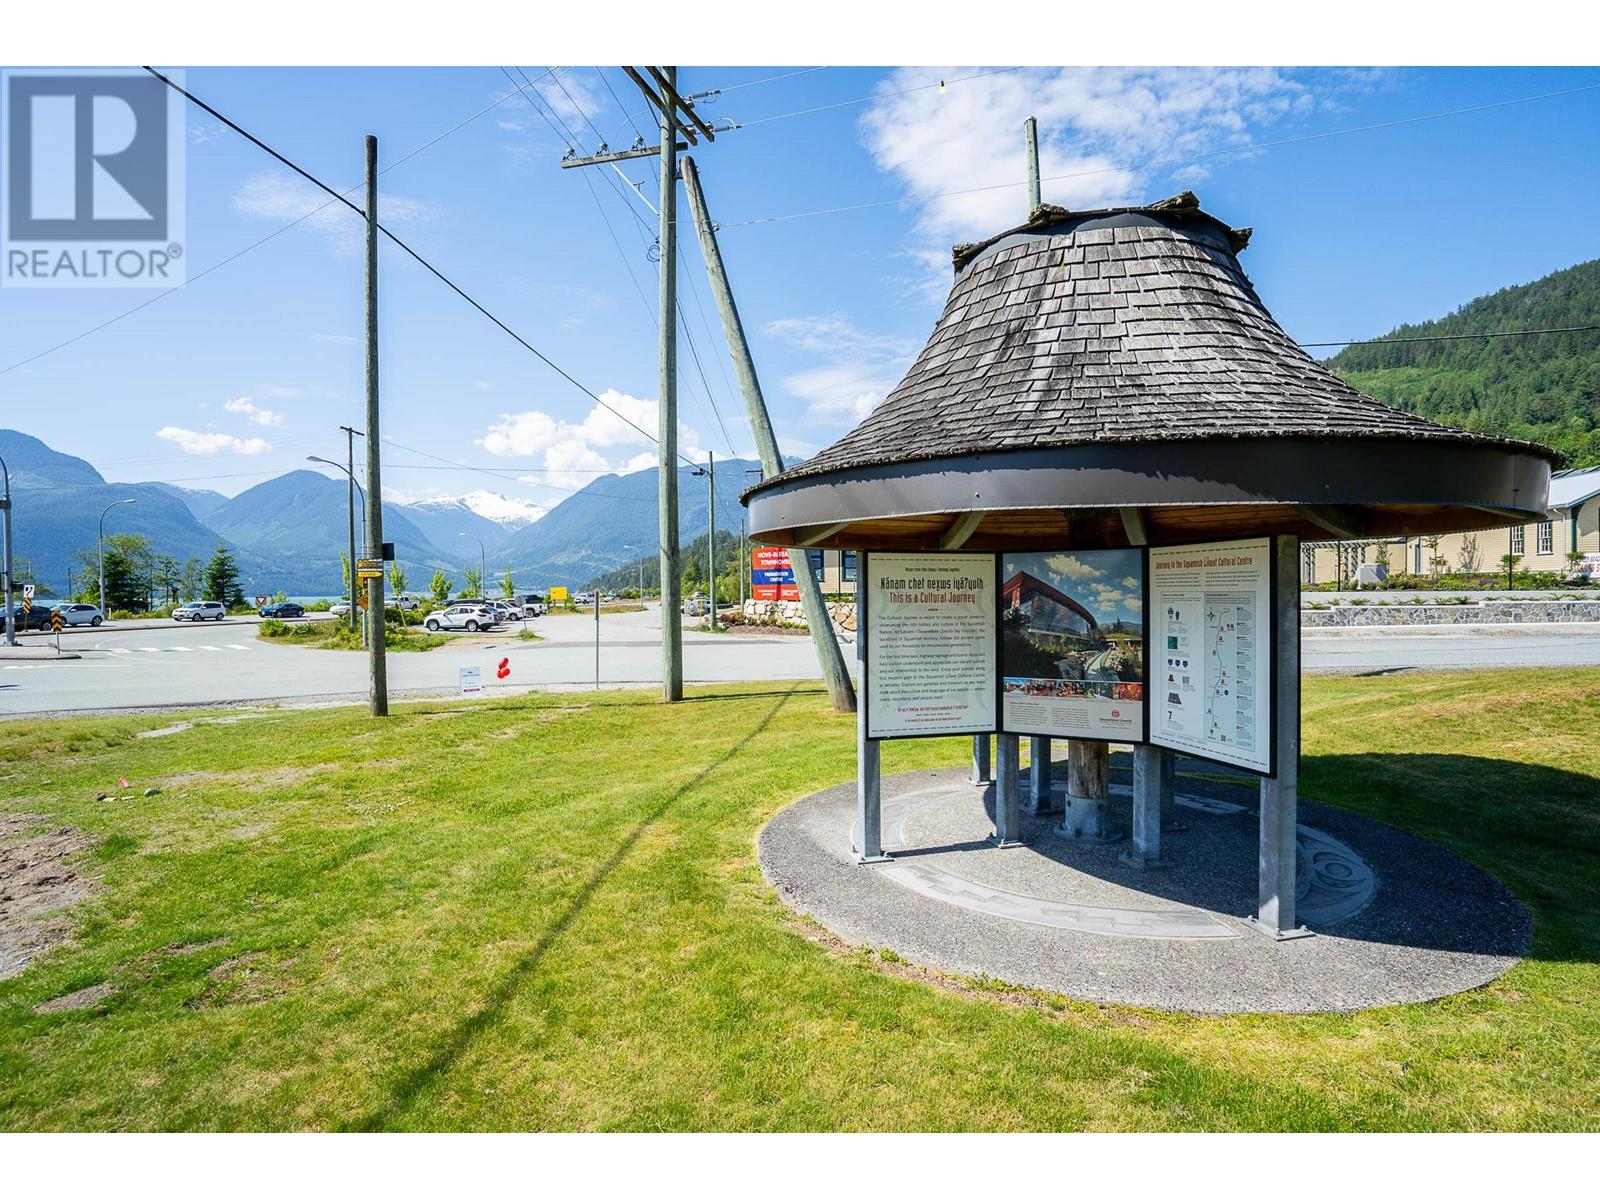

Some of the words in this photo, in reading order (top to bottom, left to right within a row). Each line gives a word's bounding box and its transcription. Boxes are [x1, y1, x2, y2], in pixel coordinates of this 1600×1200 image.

[889, 592, 904, 603] This
[905, 592, 912, 603] is
[913, 594, 919, 603] a
[920, 591, 947, 603] Cultural
[948, 592, 976, 604] Journey
